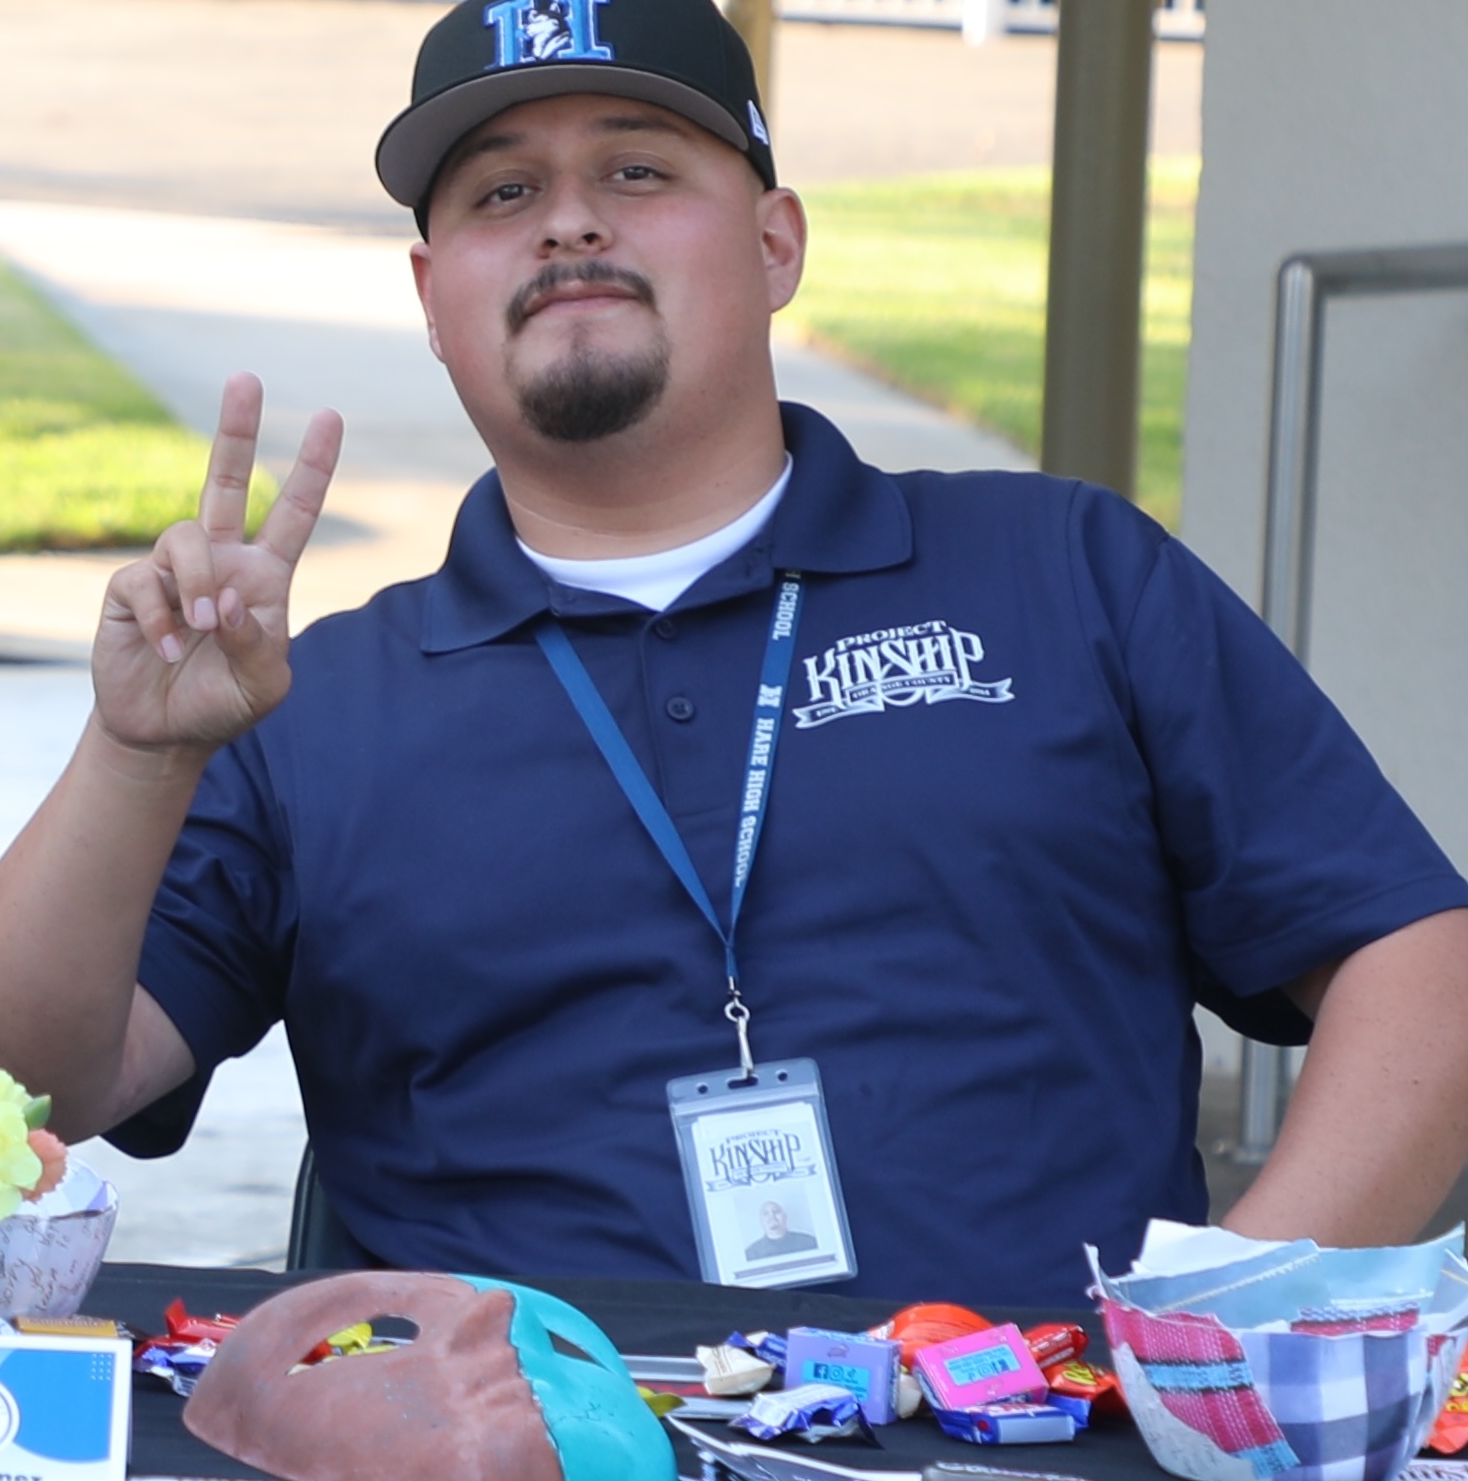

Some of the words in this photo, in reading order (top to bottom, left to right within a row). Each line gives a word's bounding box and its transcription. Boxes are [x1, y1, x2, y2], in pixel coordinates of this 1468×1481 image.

[772, 581, 800, 641] SCHOOL
[835, 619, 948, 652] PROJECT
[802, 626, 985, 708] KINSHIP
[750, 718, 775, 766] HARE
[742, 768, 767, 813] HIGH
[709, 1132, 802, 1183] KINSHIP
